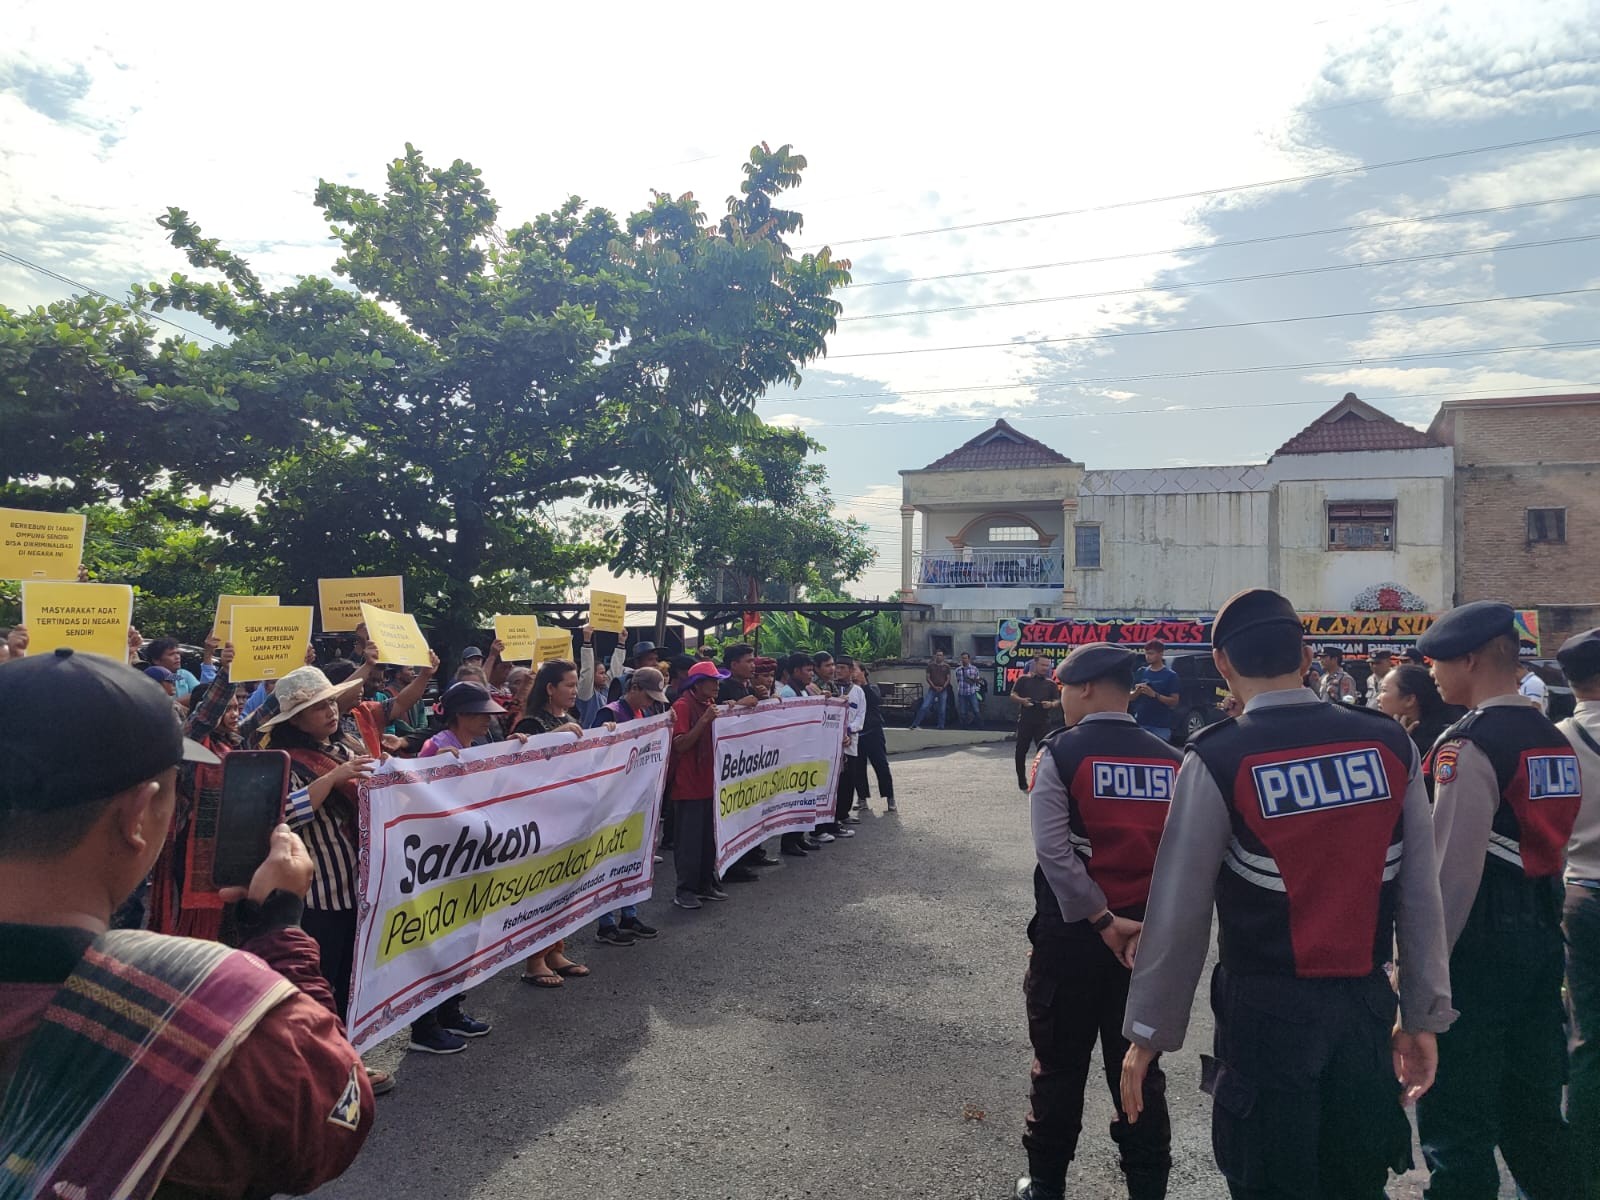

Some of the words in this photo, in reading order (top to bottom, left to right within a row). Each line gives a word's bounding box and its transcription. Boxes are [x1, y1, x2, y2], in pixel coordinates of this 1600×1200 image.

[36, 617, 80, 626] TERTINDAS
[41, 606, 96, 614] MASYARAKAT
[98, 607, 118, 615] ADAT
[65, 629, 95, 637] SENDIRI
[1021, 624, 1111, 644] SELAMAT
[1118, 624, 1205, 643] SUKSES
[721, 744, 780, 782] Bebaskan
[1096, 764, 1175, 798] POLISI
[1260, 753, 1386, 812] POLISI
[400, 820, 541, 894] Sahkan
[384, 891, 459, 956] Perda
[463, 848, 591, 919] Masyarakat
